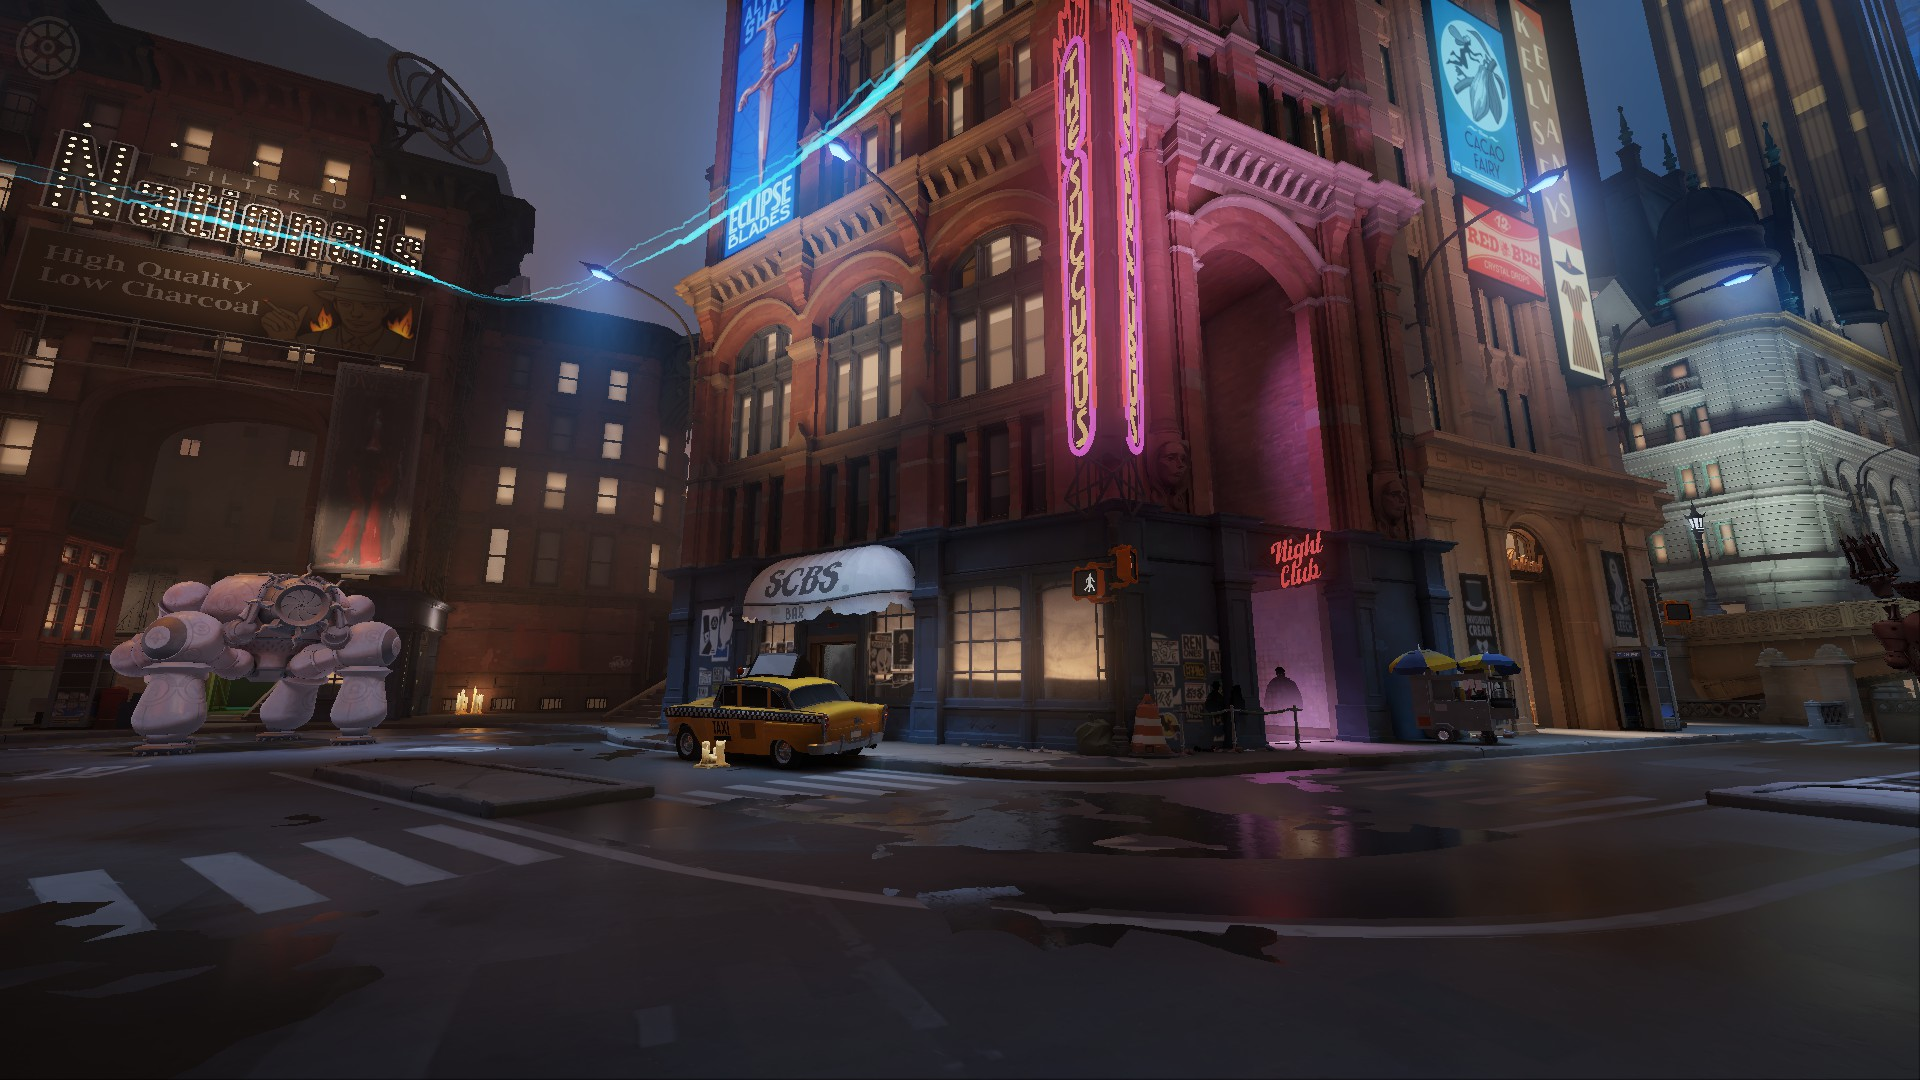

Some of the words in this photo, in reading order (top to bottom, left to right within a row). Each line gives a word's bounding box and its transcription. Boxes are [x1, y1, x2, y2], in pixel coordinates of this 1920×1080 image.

[1464, 130, 1505, 163] CACAO
[1473, 153, 1500, 179] FAIRY
[40, 129, 424, 277] Nationals
[186, 165, 348, 211] FILTERED
[728, 174, 793, 236] ECLIPSE
[727, 204, 791, 250] BLADES
[1467, 226, 1499, 253] RED
[1510, 243, 1541, 270] BEE
[46, 244, 126, 275] High
[137, 260, 253, 296] Quality
[1483, 259, 1511, 278] CRYSTAL
[38, 265, 112, 291] Low
[121, 279, 260, 317] Charcoal
[1270, 530, 1324, 565] Night
[764, 560, 843, 598] SCBS
[1280, 558, 1322, 589] Club
[785, 605, 805, 620] BAR
[1182, 635, 1202, 650] REN
[1468, 624, 1492, 637] CREAM
[712, 720, 731, 736] TAXI
